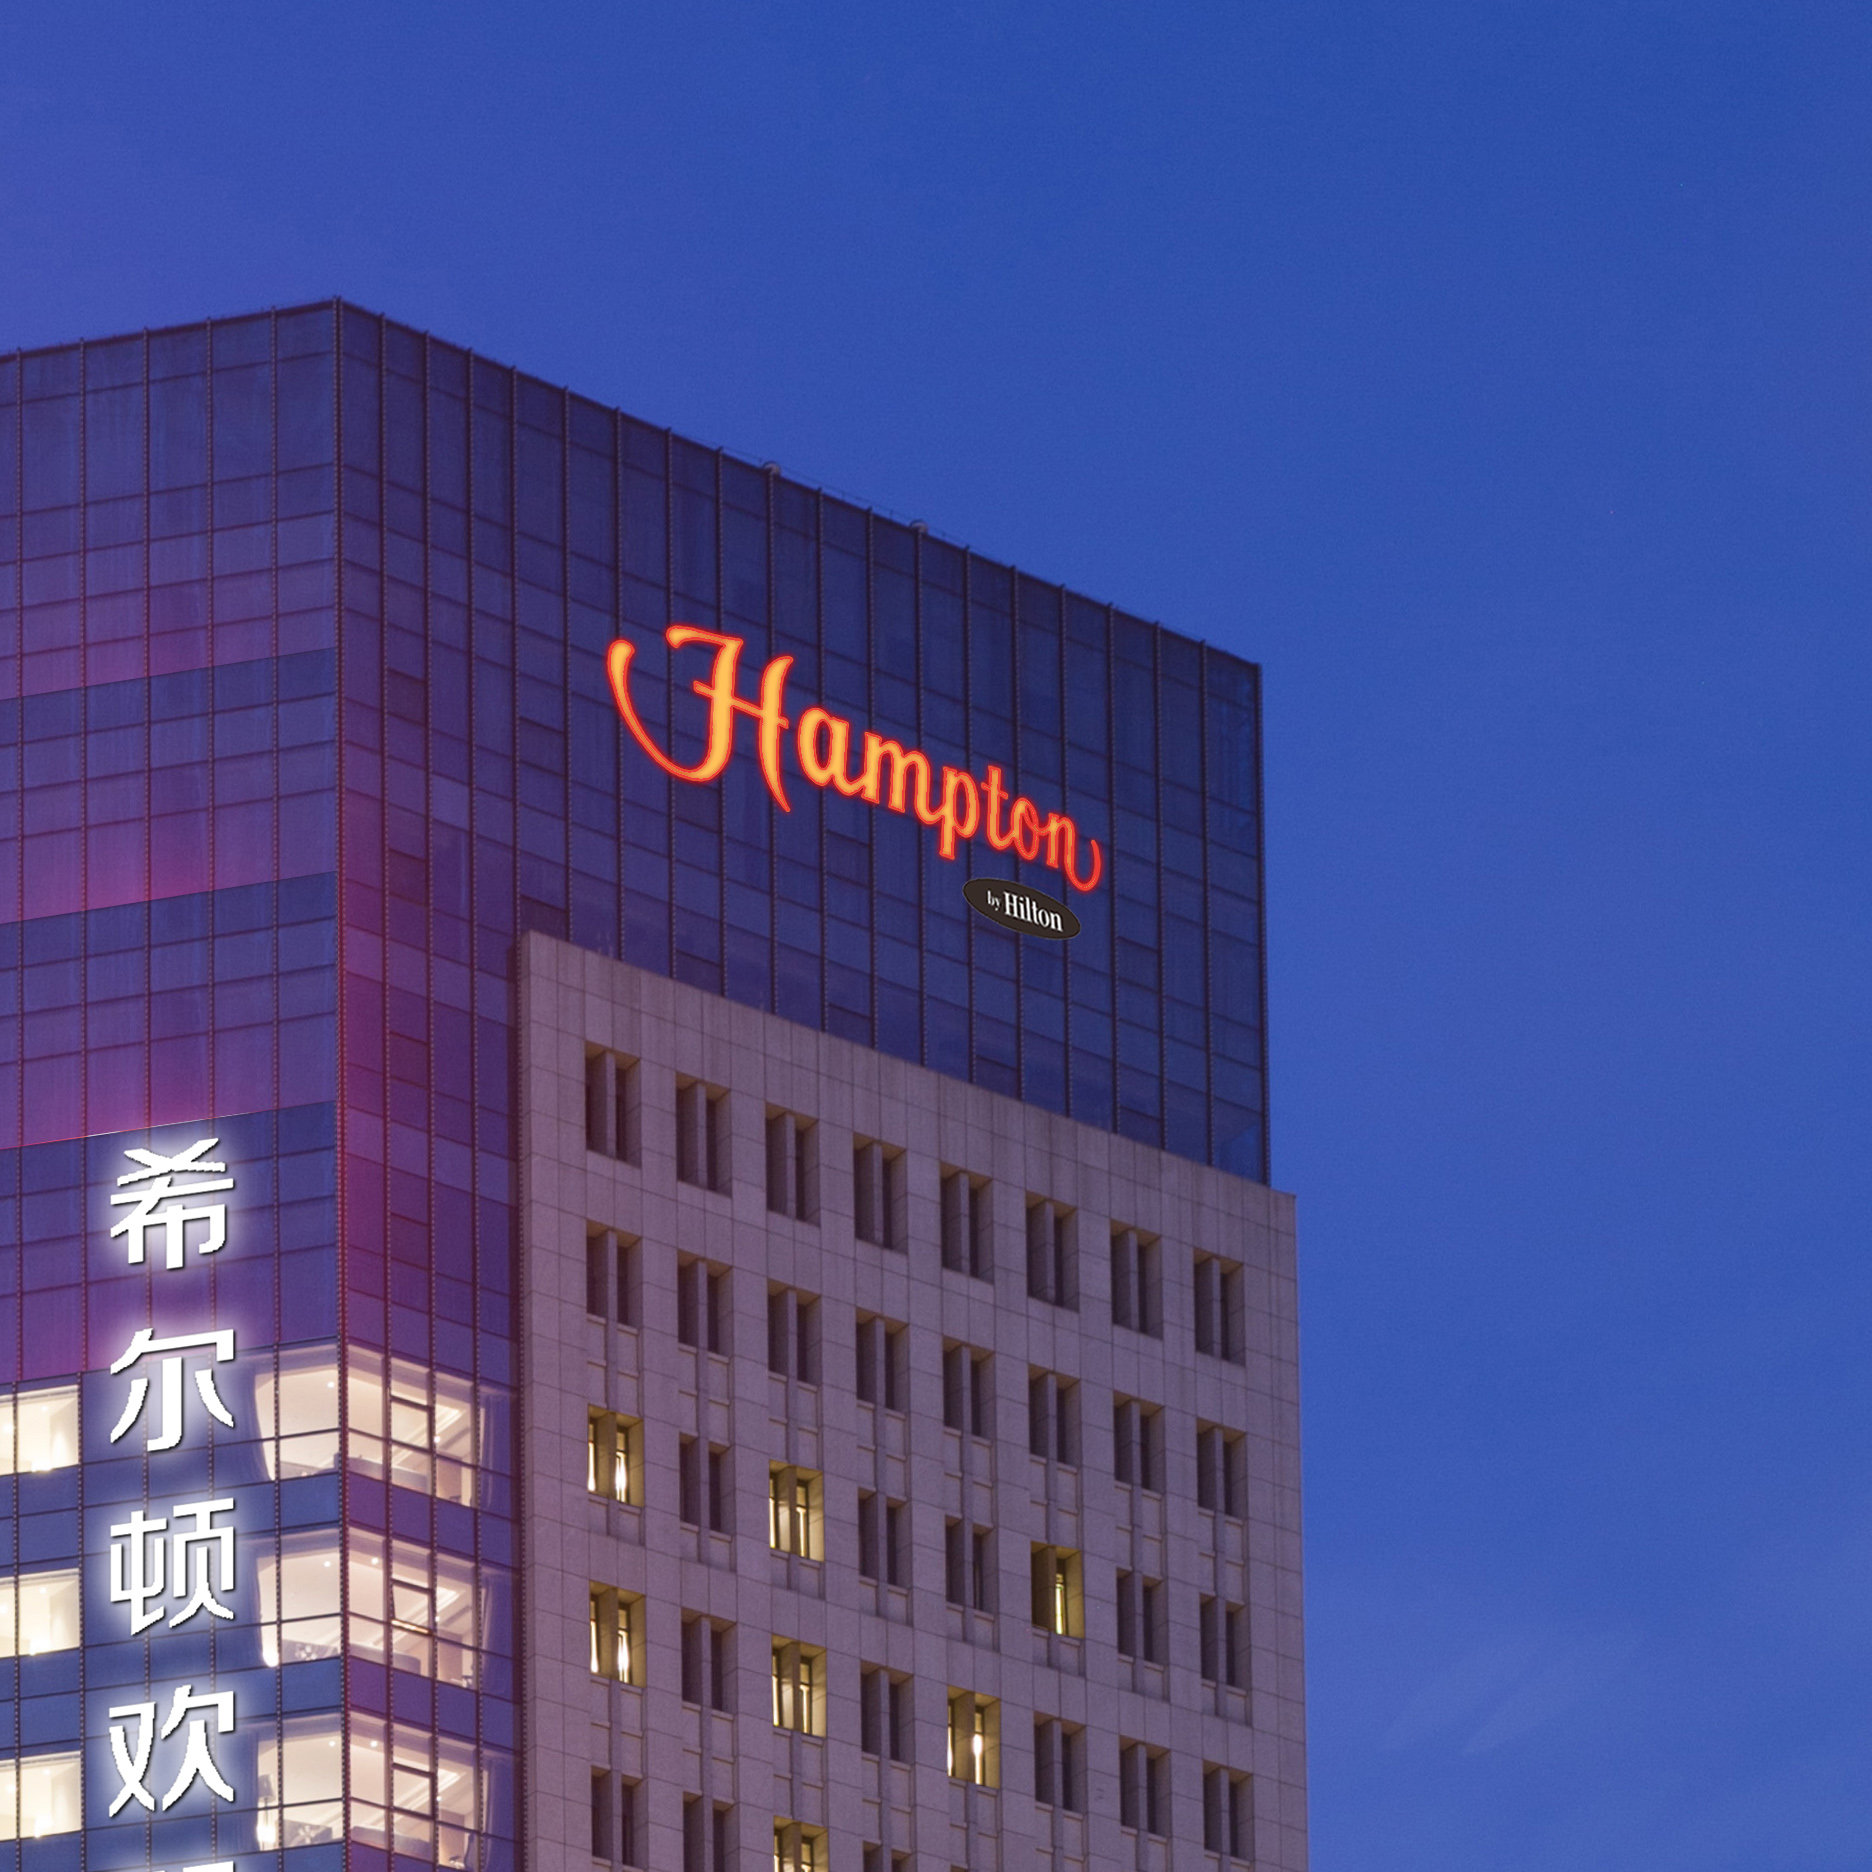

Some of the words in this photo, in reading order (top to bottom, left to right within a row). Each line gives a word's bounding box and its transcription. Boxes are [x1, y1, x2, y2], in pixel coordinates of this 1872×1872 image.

[606, 624, 1103, 893] Hampton
[987, 889, 1001, 910] by
[1003, 892, 1063, 932] Hilton
